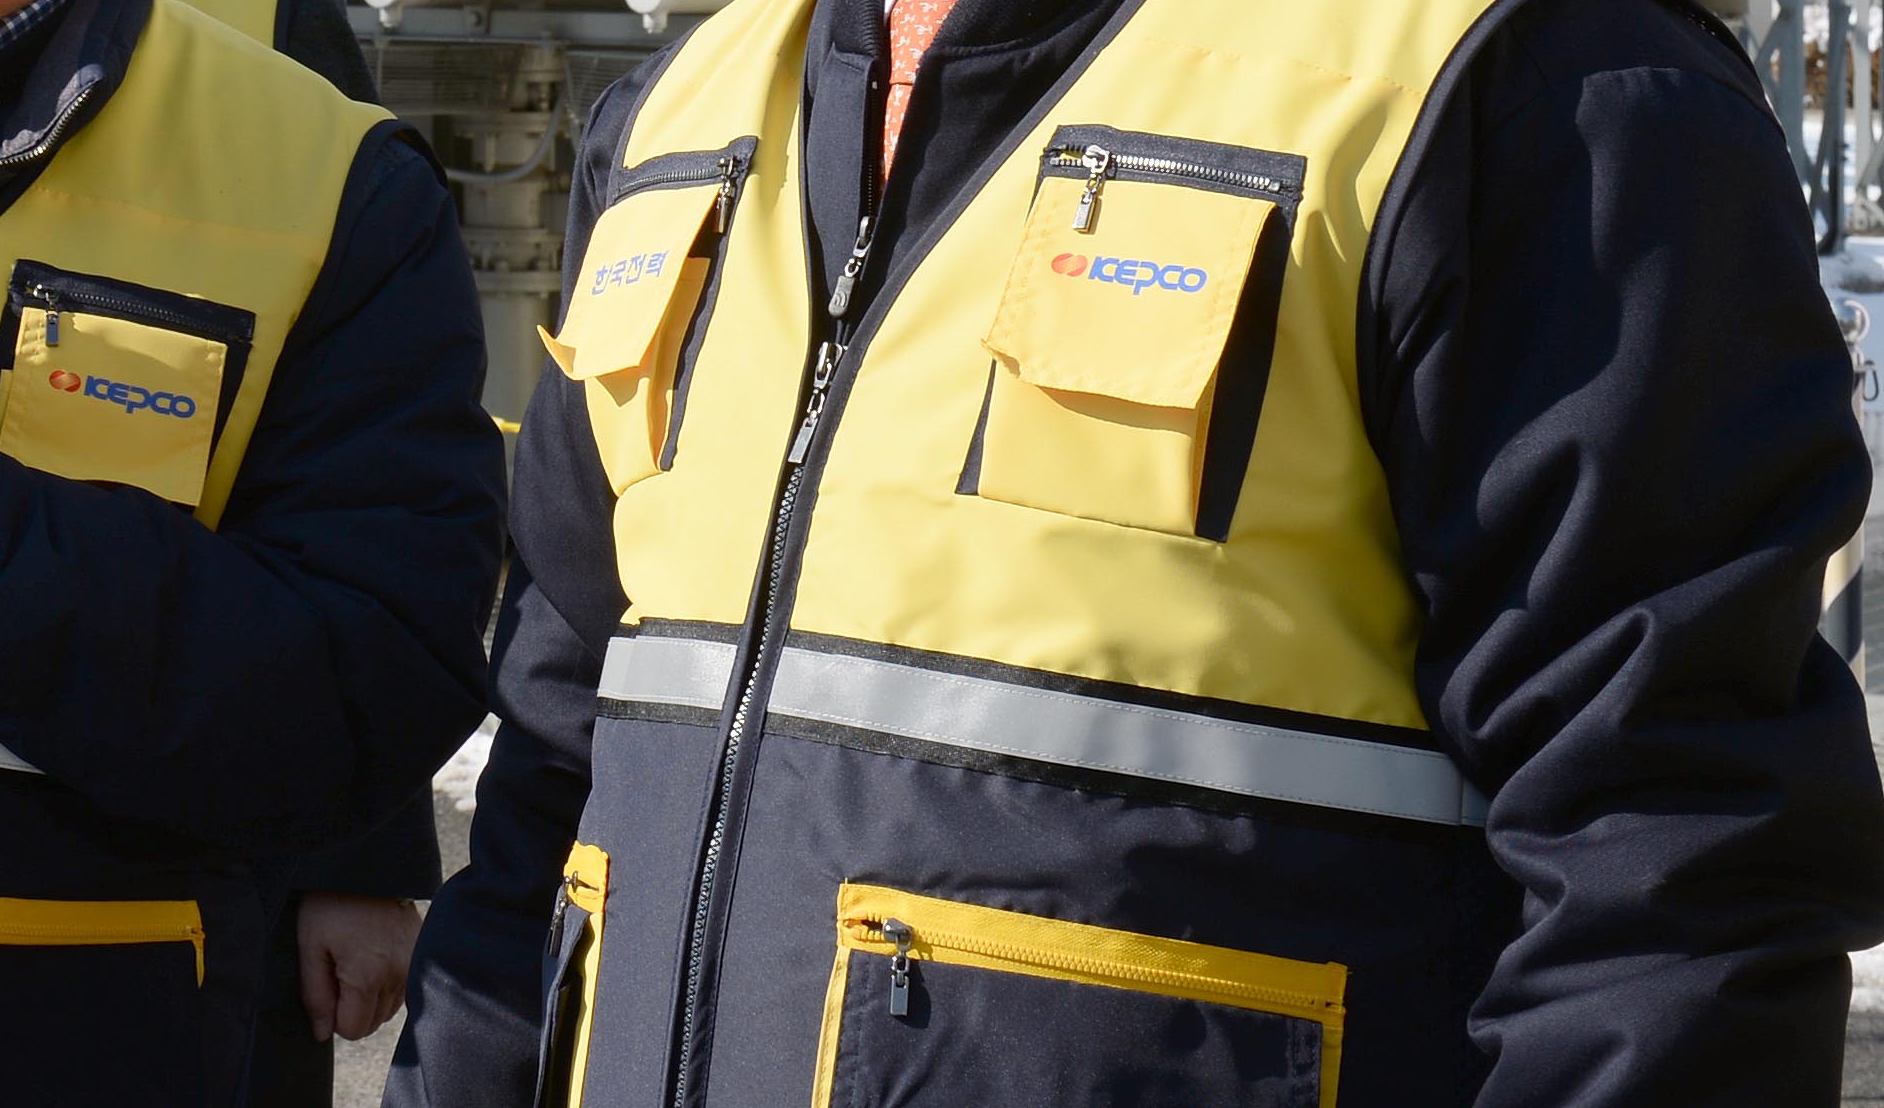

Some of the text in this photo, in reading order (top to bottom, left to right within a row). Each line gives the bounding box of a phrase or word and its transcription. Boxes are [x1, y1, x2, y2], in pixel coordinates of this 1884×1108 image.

[591, 249, 670, 296] 한국전력
[1088, 255, 1208, 296] KEPCO
[83, 375, 197, 419] KEPCO
